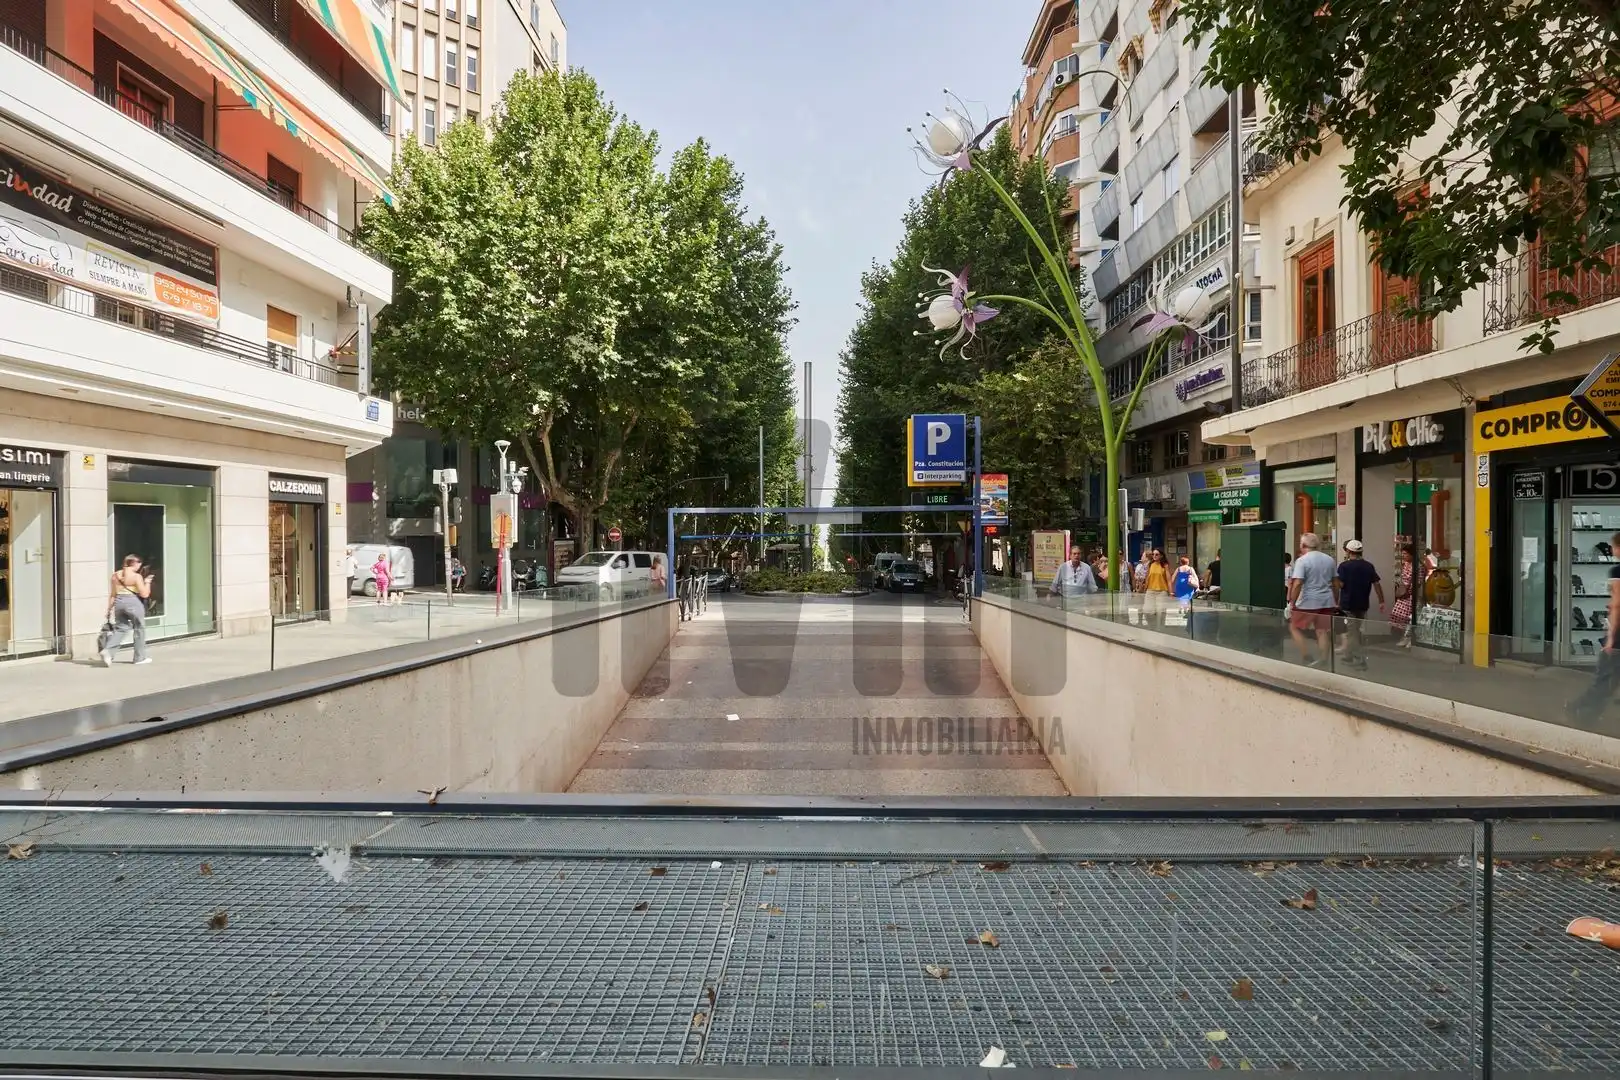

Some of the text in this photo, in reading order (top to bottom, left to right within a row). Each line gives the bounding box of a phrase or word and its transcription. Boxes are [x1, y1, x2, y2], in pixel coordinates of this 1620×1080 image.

[94, 253, 140, 280] REVISTA
[89, 270, 121, 288] SIEMPRE
[122, 281, 127, 291] A
[927, 422, 951, 456] P
[1391, 421, 1402, 448] &
[14, 471, 51, 483] lingerie
[269, 480, 323, 495] CALZEDONIA
[1213, 491, 1220, 499] LA
[1220, 490, 1231, 499] CASA
[1239, 488, 1249, 497] LAS
[927, 495, 949, 503] LIBRE
